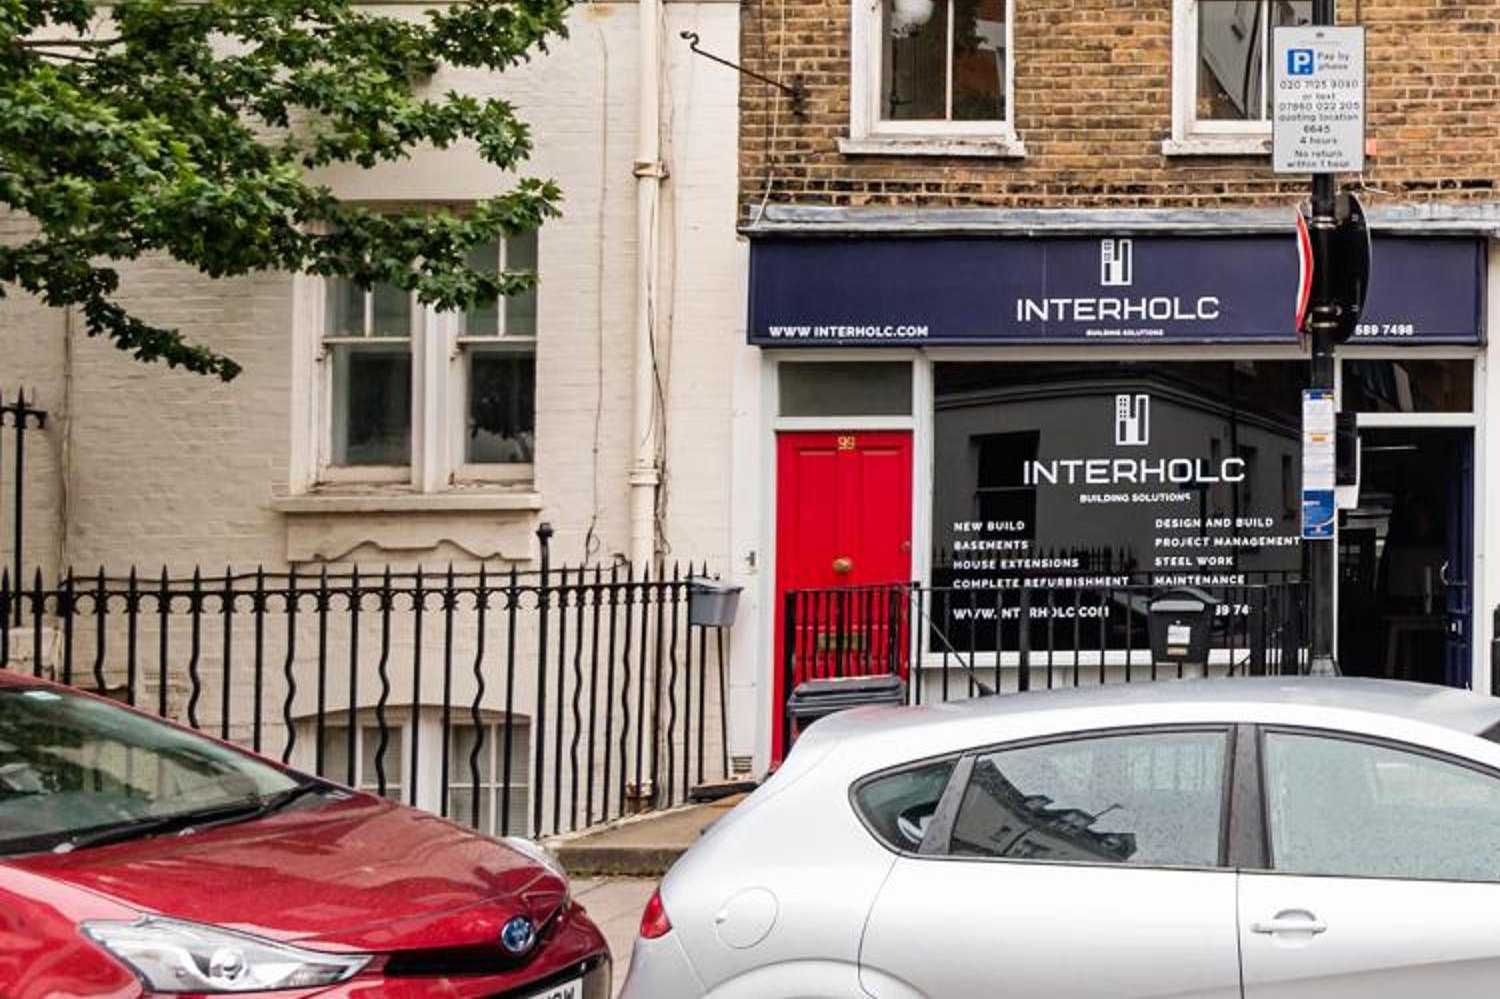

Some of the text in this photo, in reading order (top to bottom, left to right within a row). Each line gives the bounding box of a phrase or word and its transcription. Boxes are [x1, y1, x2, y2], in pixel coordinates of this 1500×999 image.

[1016, 296, 1220, 322] INTERHOLC
[1023, 457, 1246, 485] INTERHOLC
[1079, 493, 1130, 503] BUILDING
[953, 521, 1025, 532] NEW BUILD
[1155, 518, 1274, 528] DESIGN AND BUILD
[953, 540, 1030, 550] BASEMENTS
[1155, 536, 1301, 547] PROJECT MANAGEMENT
[953, 558, 1080, 569] HOUSE EXTENSIONS
[1154, 556, 1234, 566] STEEL WORK
[953, 576, 1130, 589] COMPLETE REFURBISHMENT
[1154, 574, 1245, 585] MAINTENANCE
